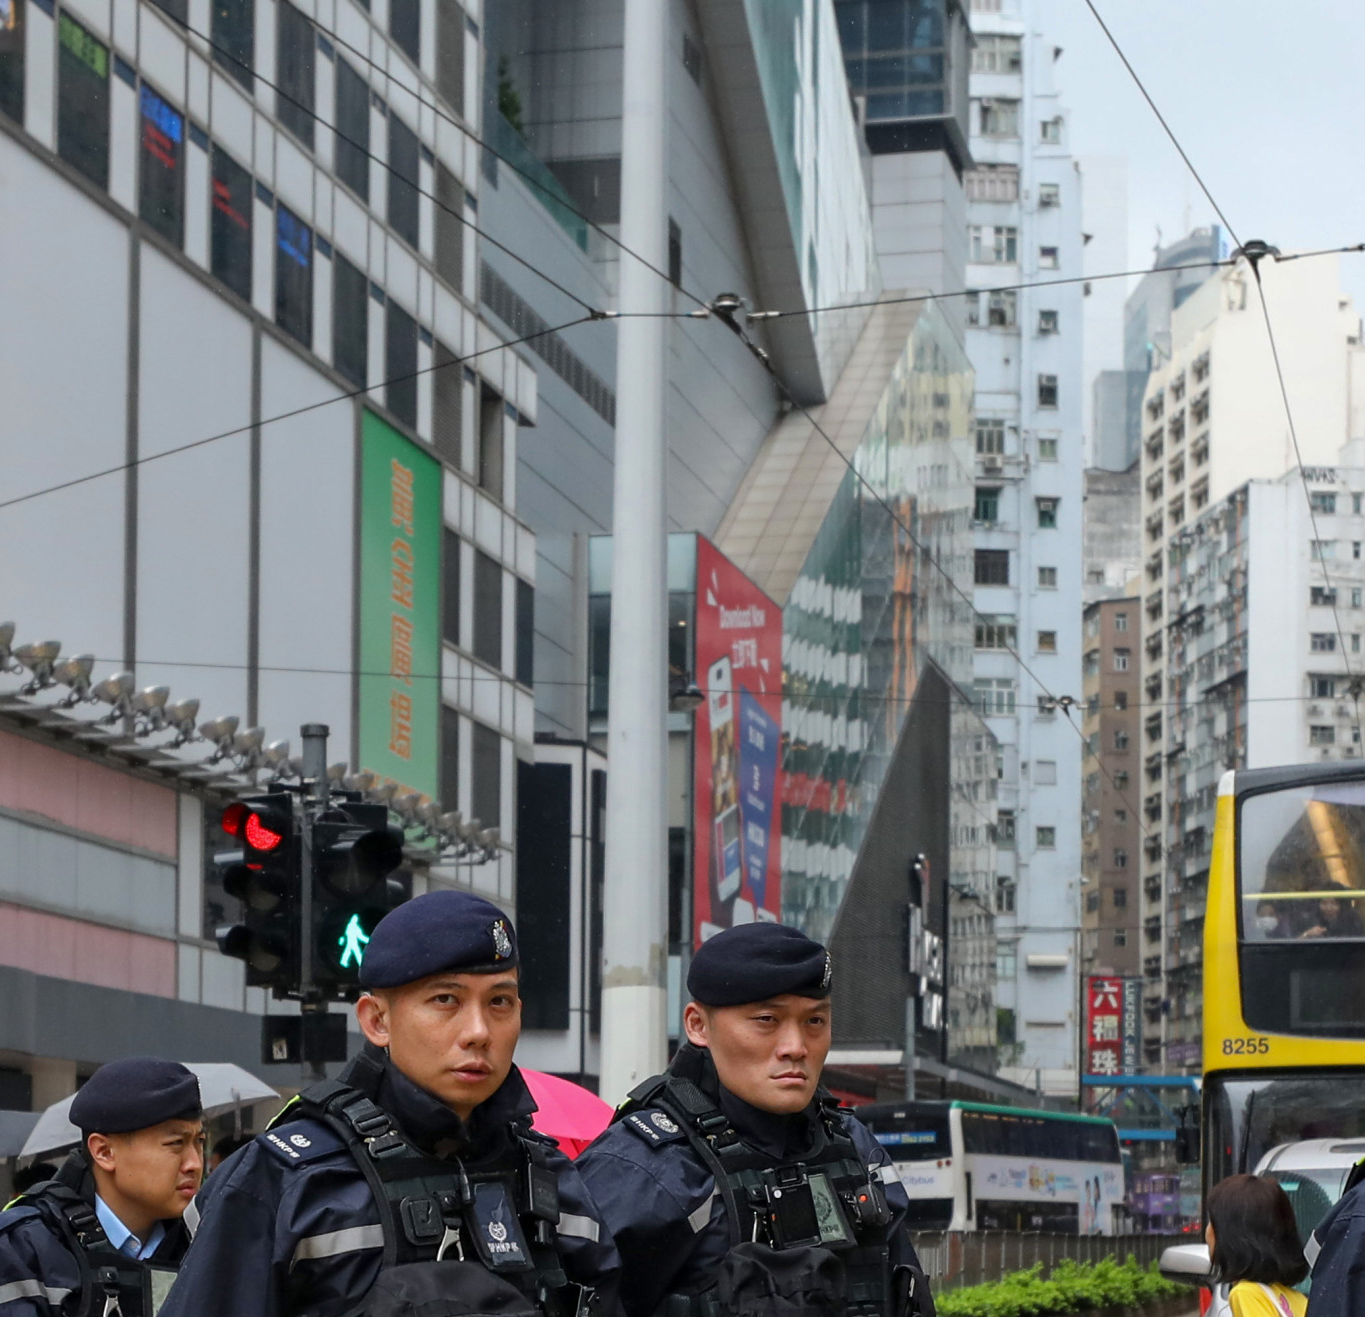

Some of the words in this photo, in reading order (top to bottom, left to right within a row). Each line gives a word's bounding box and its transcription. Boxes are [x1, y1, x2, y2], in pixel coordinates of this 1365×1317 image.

[1125, 982, 1134, 1036] LUKFOOK
[1223, 1038, 1269, 1055] 8255
[902, 1176, 935, 1186] Citybus
